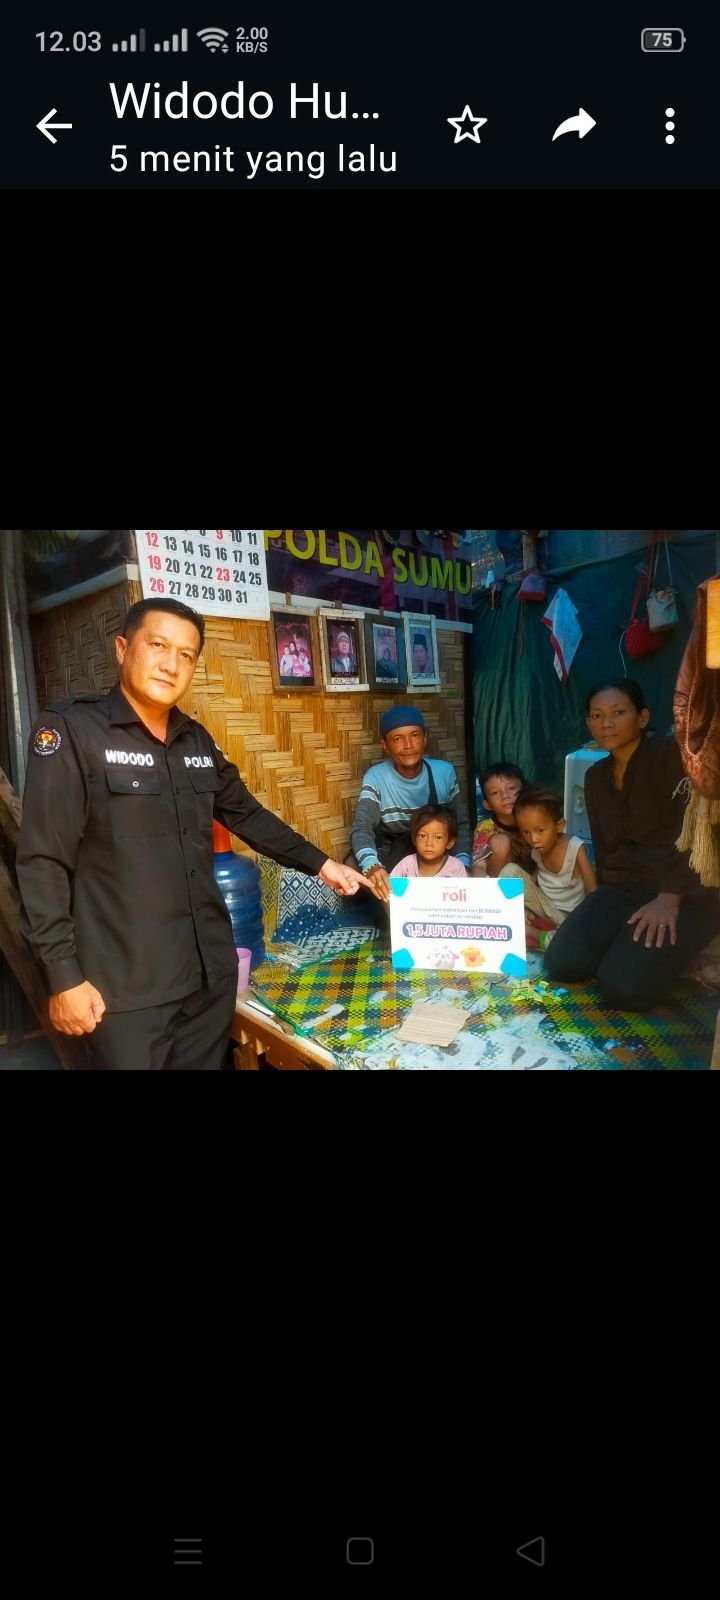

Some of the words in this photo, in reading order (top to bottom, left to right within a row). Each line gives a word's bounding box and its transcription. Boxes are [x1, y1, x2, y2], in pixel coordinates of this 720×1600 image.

[145, 532, 159, 547] 12
[164, 536, 177, 551] 13
[182, 540, 194, 555] 14
[198, 544, 210, 558] 15
[215, 547, 227, 560] 16
[233, 550, 242, 563] 17
[248, 552, 259, 566] 18
[230, 530, 241, 543] 10
[247, 532, 257, 546] 11
[147, 555, 161, 570] 19
[165, 558, 180, 573] 20
[184, 561, 196, 576] 21
[200, 565, 213, 579] 22
[216, 567, 230, 582] 23
[233, 570, 246, 583] 24
[249, 572, 261, 585] 25
[264, 530, 385, 578] POLDA
[391, 547, 472, 595] SUMU
[150, 578, 164, 593] 26
[168, 580, 181, 595] 27
[185, 583, 199, 598] 28
[201, 586, 215, 600] 29
[218, 589, 232, 602] 30
[236, 590, 248, 603] 31
[105, 749, 154, 766] WIDODO
[184, 756, 214, 768] POLRI
[442, 888, 467, 902] roli
[407, 924, 423, 938] 1,5
[425, 925, 456, 938] JUTA
[457, 926, 508, 940] RUPIAH
